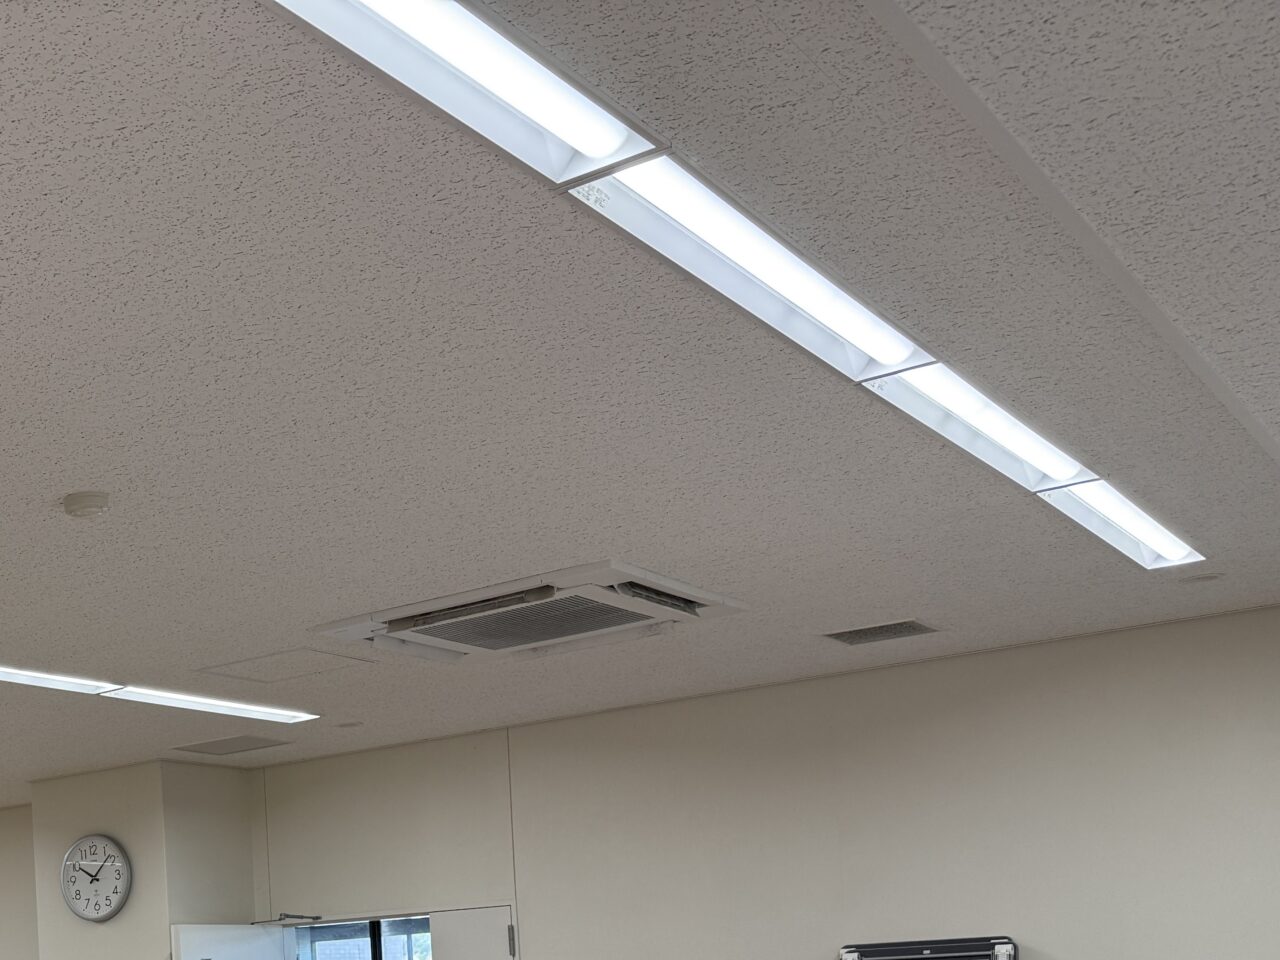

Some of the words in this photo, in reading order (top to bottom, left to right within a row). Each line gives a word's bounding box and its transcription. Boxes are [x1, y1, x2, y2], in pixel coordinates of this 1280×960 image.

[80, 849, 87, 861] 11
[89, 844, 98, 856] 12
[103, 846, 107, 857] 1
[109, 855, 116, 866] 2
[73, 861, 81, 873] 10
[114, 869, 122, 881] 3
[70, 876, 77, 887] 9
[74, 889, 81, 901] 8
[112, 885, 122, 895] 4
[85, 898, 90, 910] 7
[94, 900, 101, 911] 6
[105, 896, 112, 907] 5
